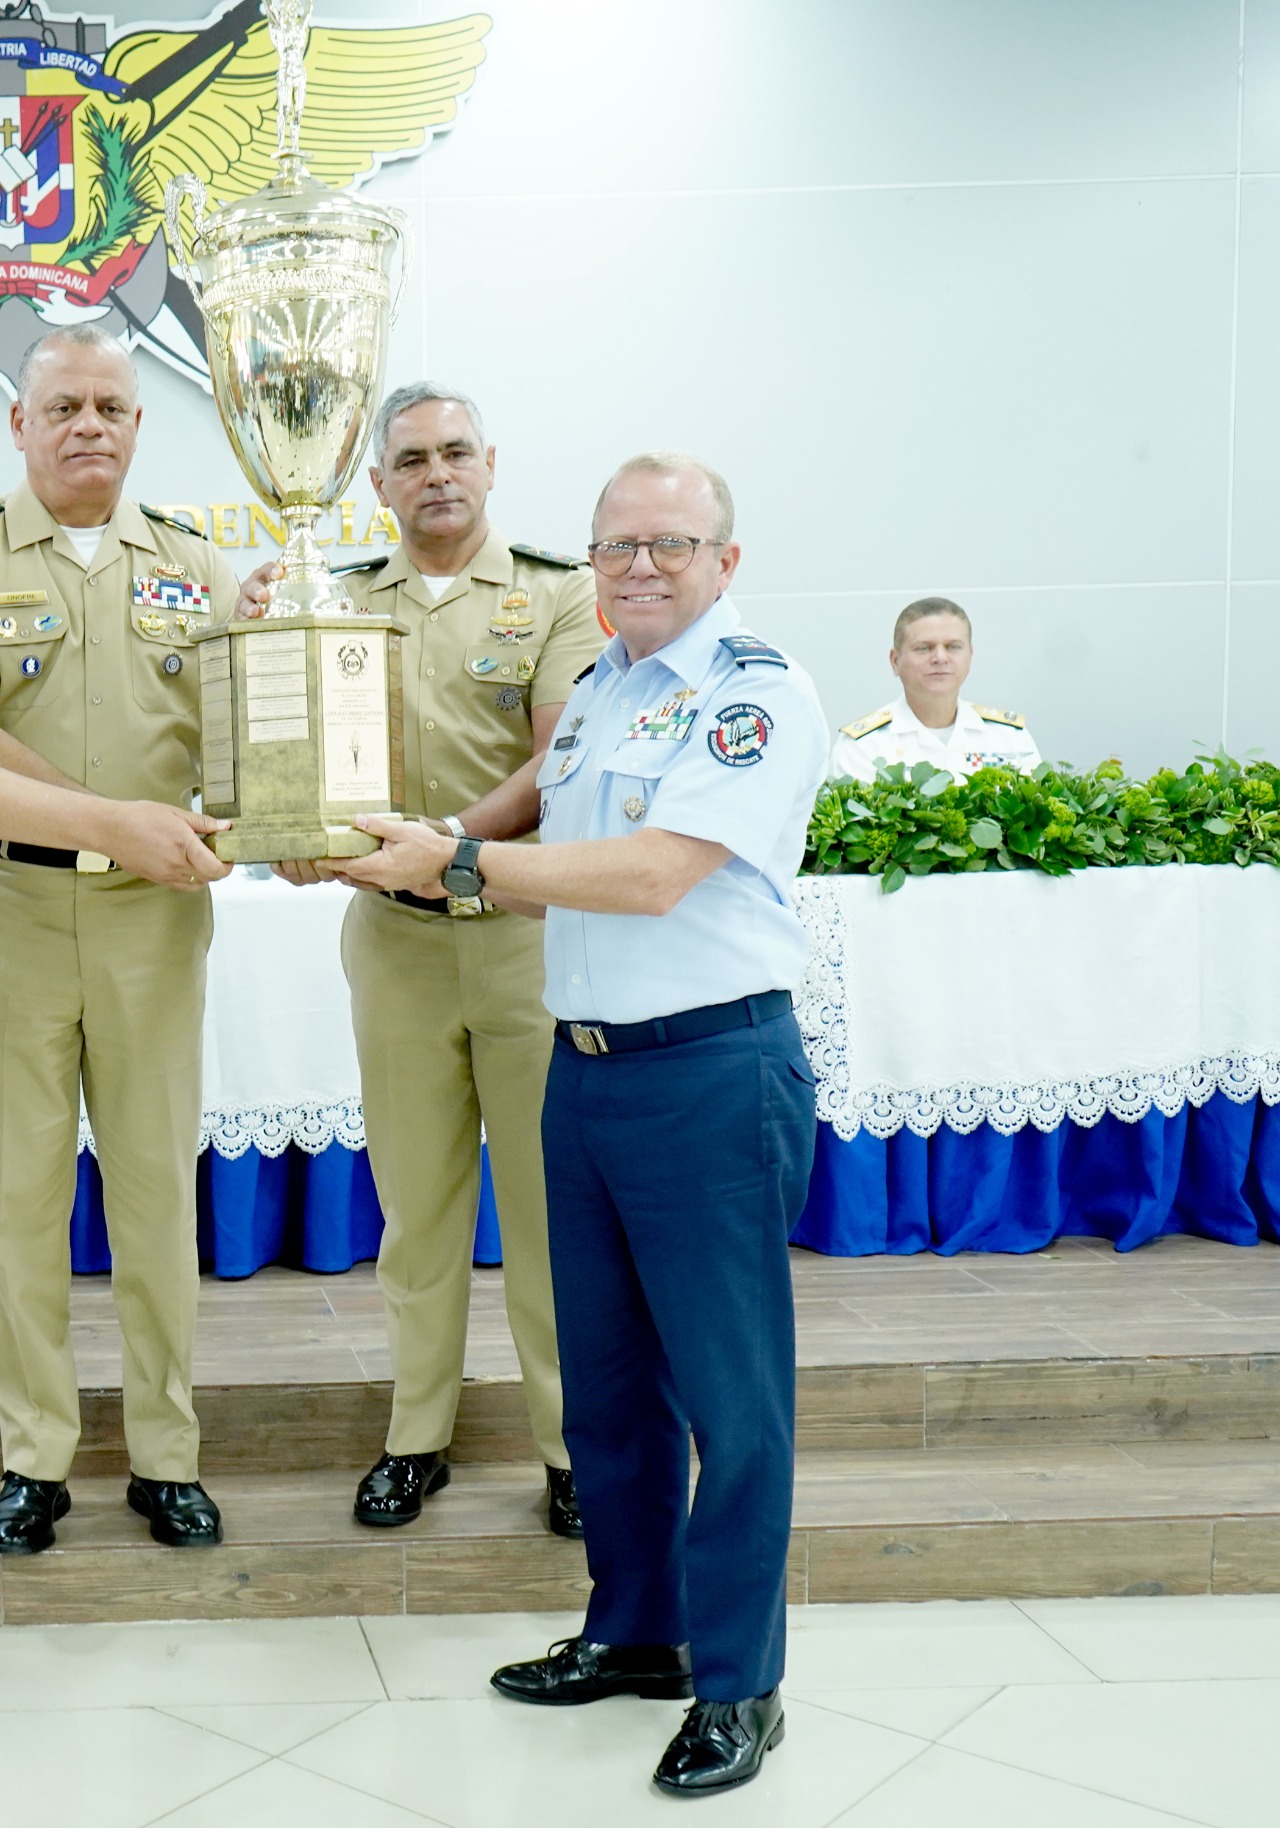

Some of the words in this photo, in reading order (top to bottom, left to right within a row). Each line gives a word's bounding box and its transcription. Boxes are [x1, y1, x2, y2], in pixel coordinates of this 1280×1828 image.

[40, 53, 98, 78] LIBERTAD
[10, 265, 89, 293] DOMINICANA
[720, 706, 744, 720] FUERZA
